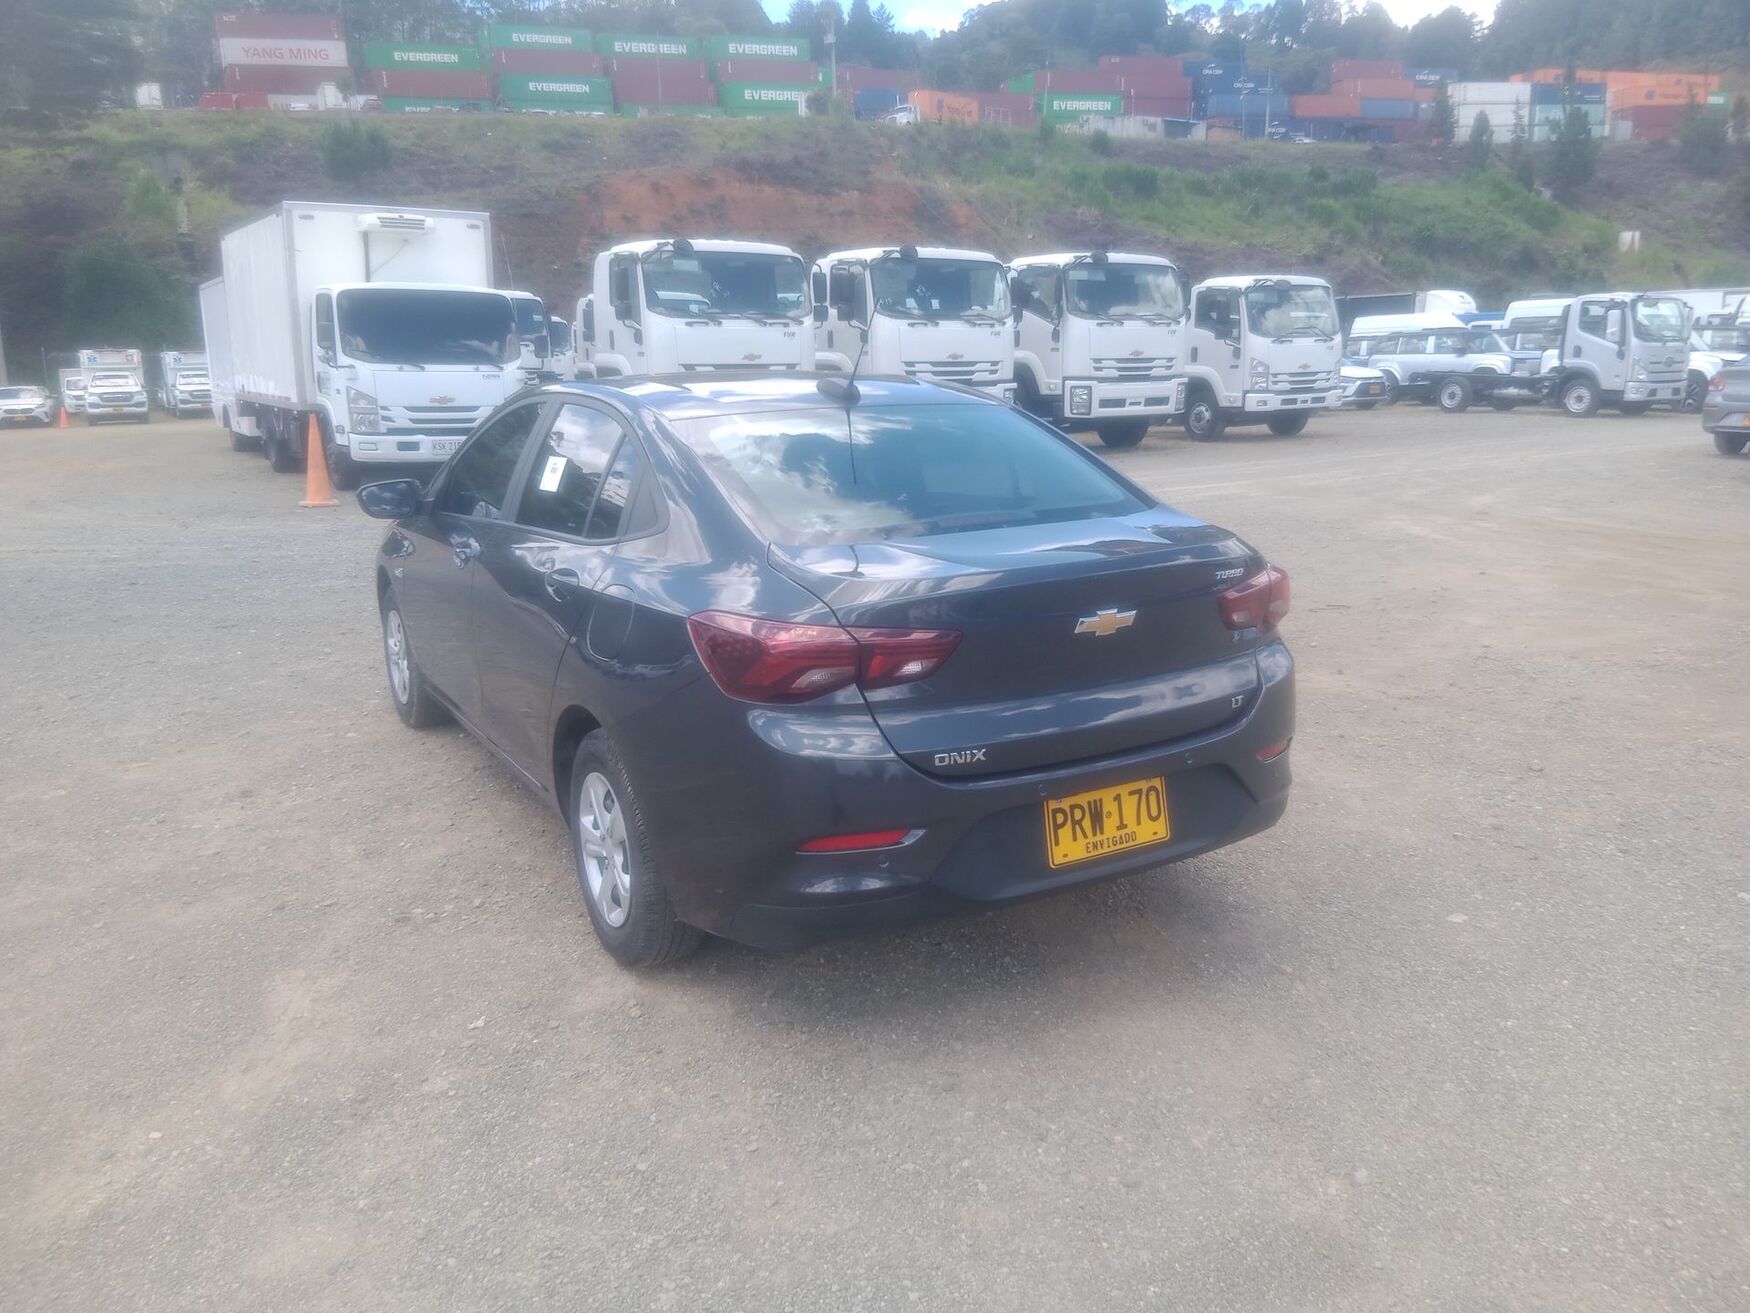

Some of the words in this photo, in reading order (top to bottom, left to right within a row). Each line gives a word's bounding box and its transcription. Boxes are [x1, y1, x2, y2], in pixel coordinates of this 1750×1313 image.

[512, 33, 572, 45] EVERGREEN
[242, 47, 284, 59] YANG
[288, 48, 329, 60] MING
[728, 43, 798, 56] EVERGREEN
[394, 51, 458, 63] EVERGREEN
[528, 81, 590, 93] EVERGREEN
[744, 89, 807, 102] EVERGRE
[1053, 100, 1111, 111] EVERGREEN
[1231, 695, 1244, 709] LT
[934, 748, 987, 767] ONIX
[1085, 830, 1137, 854] ENVIGADO
